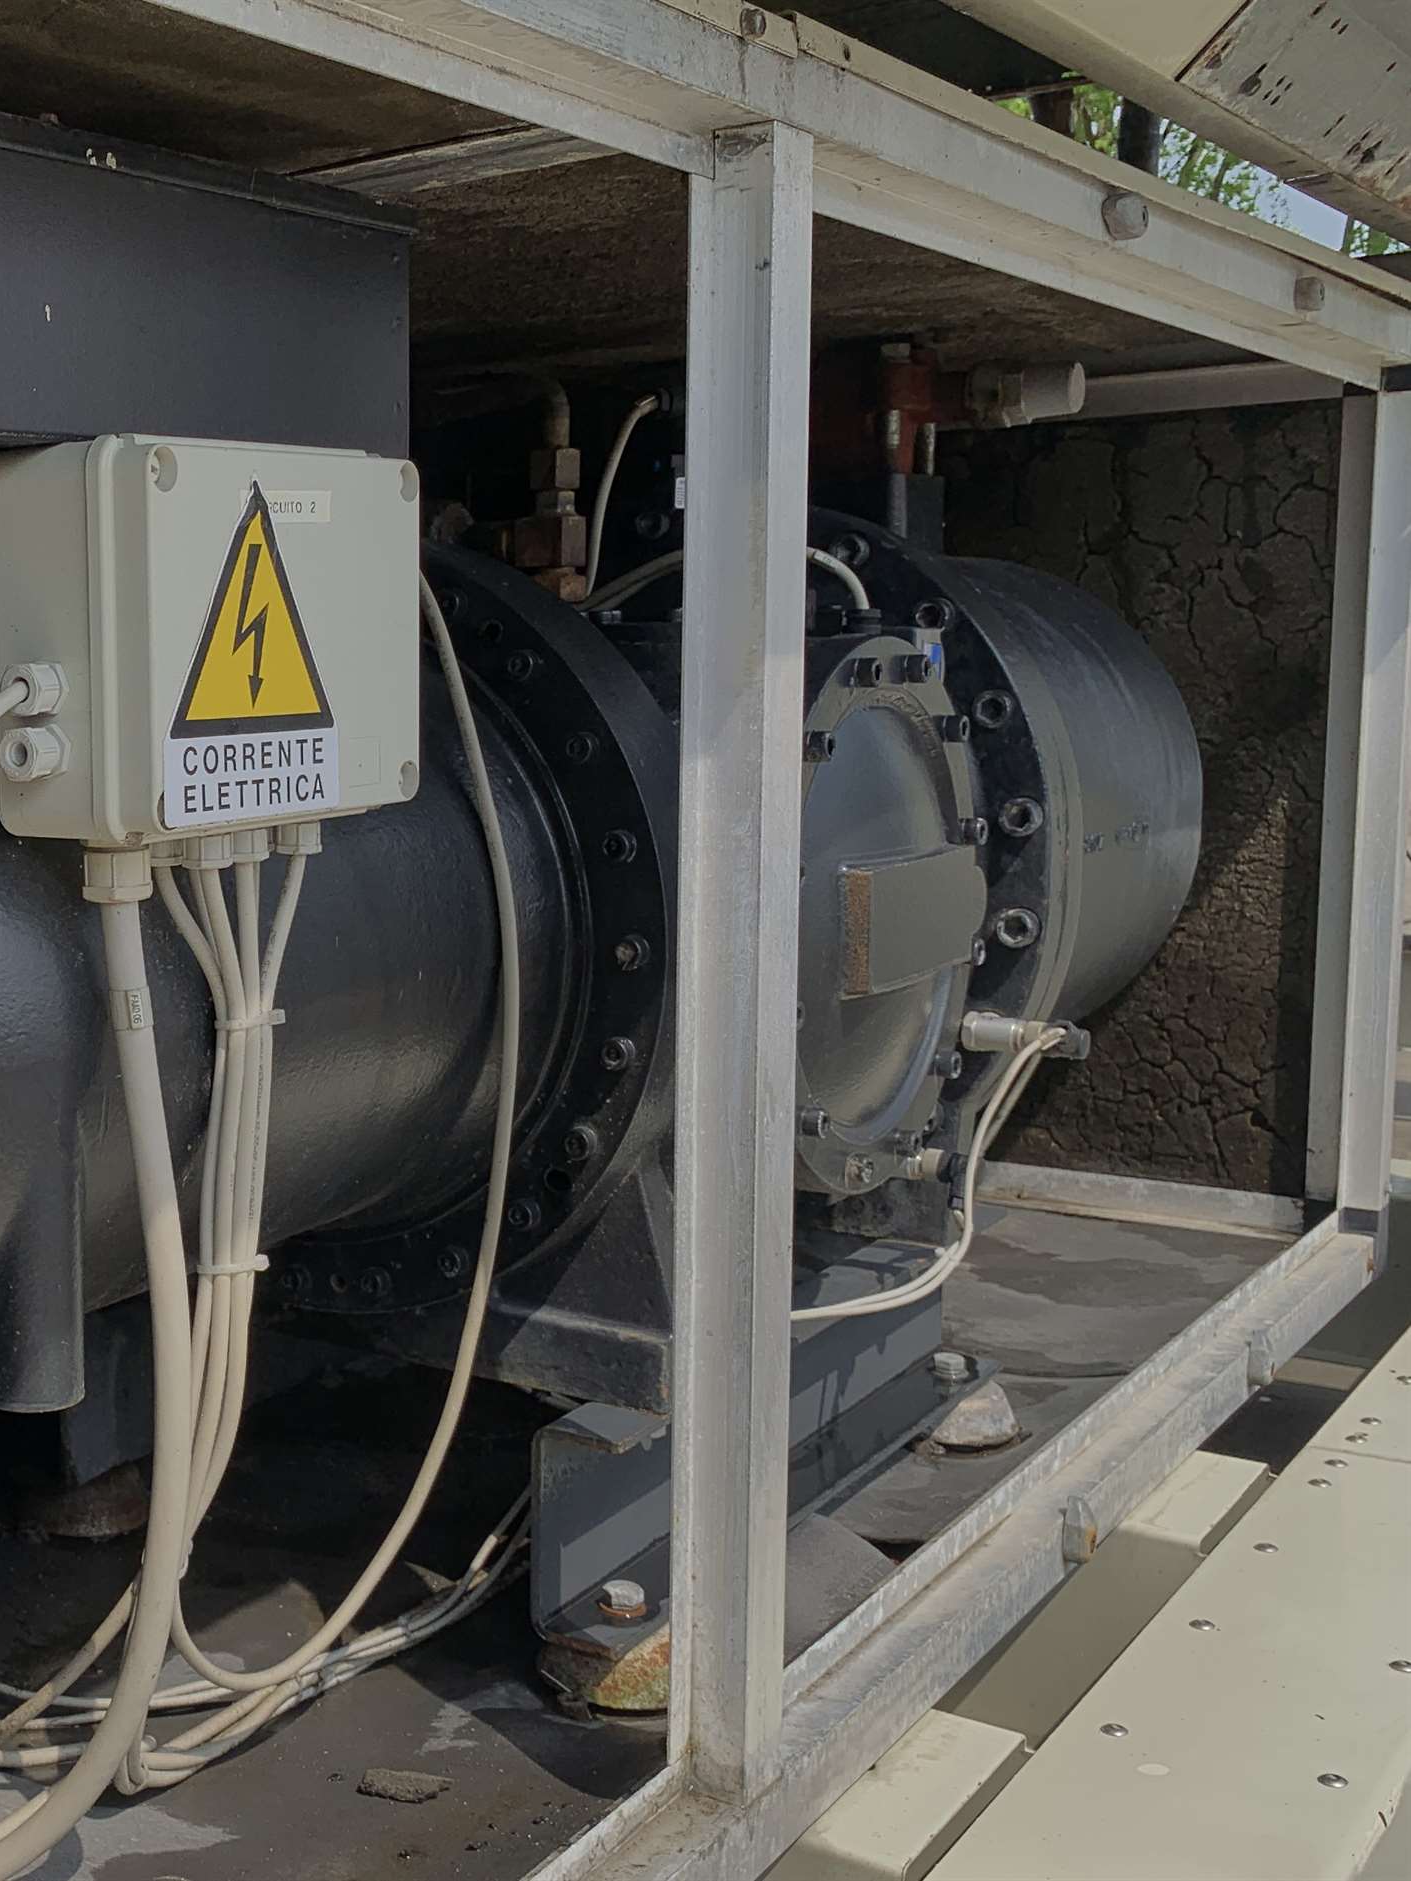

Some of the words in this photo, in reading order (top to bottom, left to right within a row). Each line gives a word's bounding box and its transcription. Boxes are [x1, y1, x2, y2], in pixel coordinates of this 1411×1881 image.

[269, 501, 302, 514] CUITO
[310, 501, 316, 514] 2
[183, 737, 325, 776] CORRENTE
[184, 773, 325, 814] ELETTRICA
